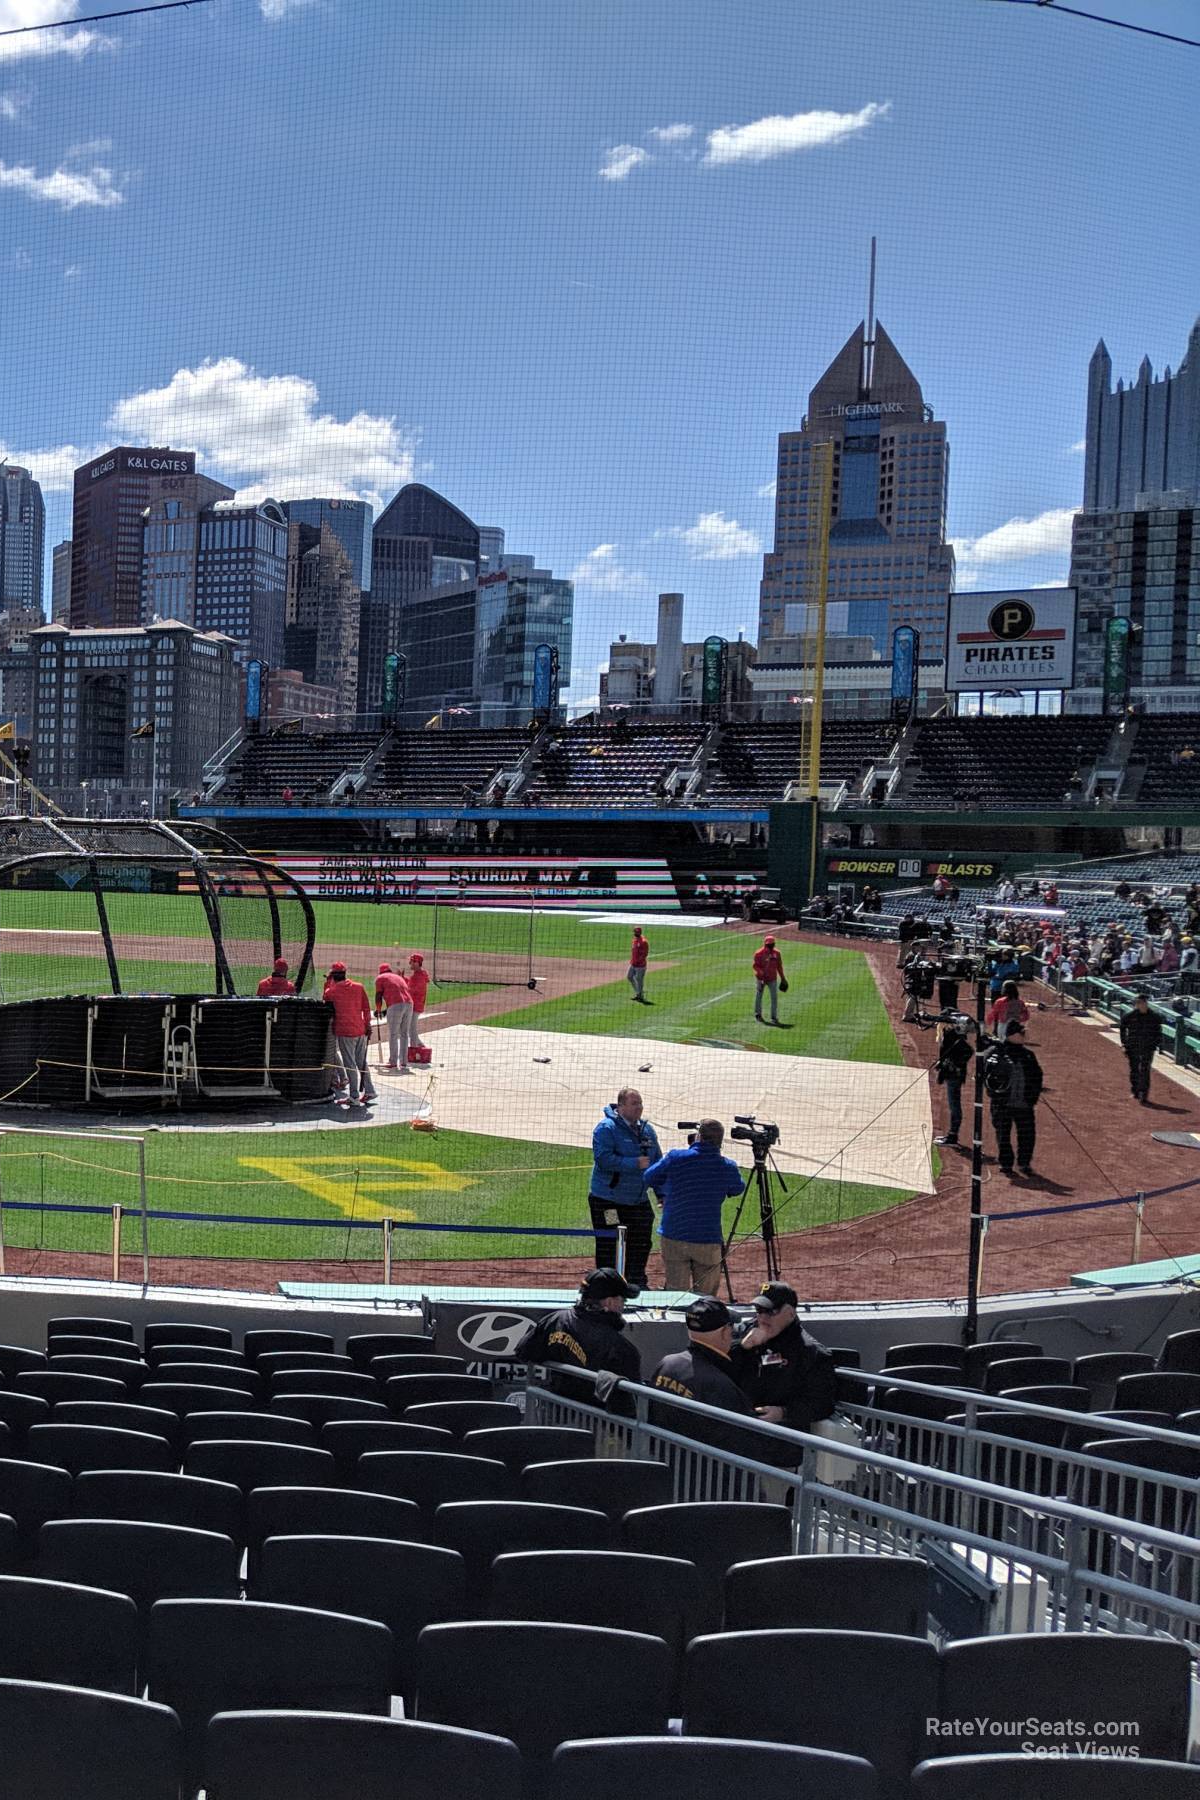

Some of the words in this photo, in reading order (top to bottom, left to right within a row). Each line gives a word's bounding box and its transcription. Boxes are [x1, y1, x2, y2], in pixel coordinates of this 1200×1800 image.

[830, 402, 904, 417] HIGHMARK
[127, 457, 148, 469] K&L
[150, 458, 188, 471] GATES
[1002, 608, 1023, 633] P
[965, 645, 1056, 663] PIRATES
[964, 662, 1056, 675] CHARITIES
[319, 856, 373, 867] JAMESON
[378, 857, 427, 868] TAILLON
[838, 861, 895, 873] BOWSER
[937, 863, 993, 875] BLASTS
[318, 869, 352, 880] STAR
[357, 870, 396, 882] WARS
[450, 870, 529, 882] SATURDAY
[538, 870, 573, 882] MAY
[318, 884, 416, 896] BUBBLEHEAD
[601, 888, 618, 896] PM
[760, 1283, 770, 1295] P
[655, 1375, 694, 1398] STAFF
